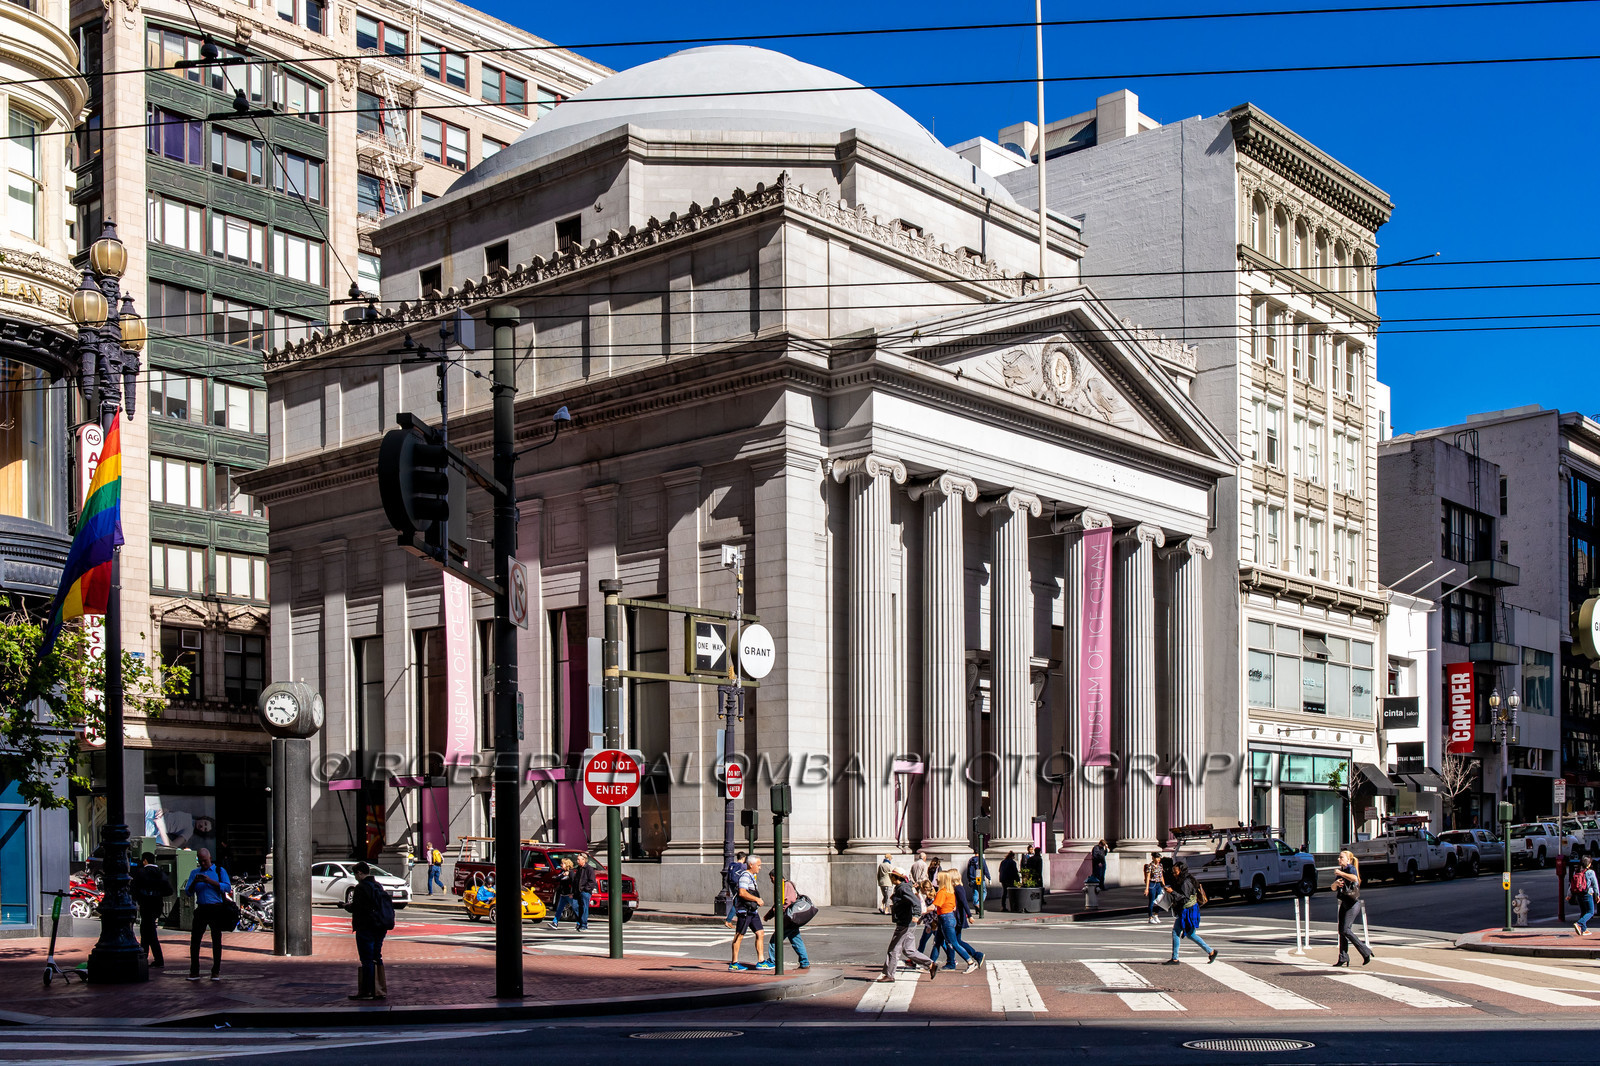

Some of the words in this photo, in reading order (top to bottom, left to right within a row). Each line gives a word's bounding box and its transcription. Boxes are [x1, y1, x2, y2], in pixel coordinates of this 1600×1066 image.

[0, 279, 43, 304] LAN
[1089, 543, 1105, 604] CREAM
[449, 575, 463, 608] CRE
[451, 615, 465, 642] ICE
[1089, 610, 1104, 638] ICE
[697, 641, 709, 650] ONE
[711, 643, 724, 651] WAY
[744, 646, 771, 657] GRANT
[1087, 646, 1104, 670] OF
[453, 648, 466, 673] OF
[454, 679, 469, 752] MUSEUM
[1088, 676, 1104, 750] MUSEUM
[1383, 709, 1404, 717] cinta
[1451, 672, 1471, 742] CAMPER
[593, 760, 608, 770] DO
[611, 761, 632, 771] NOT
[596, 785, 628, 795] ENTER
[729, 785, 741, 793] ENTER
